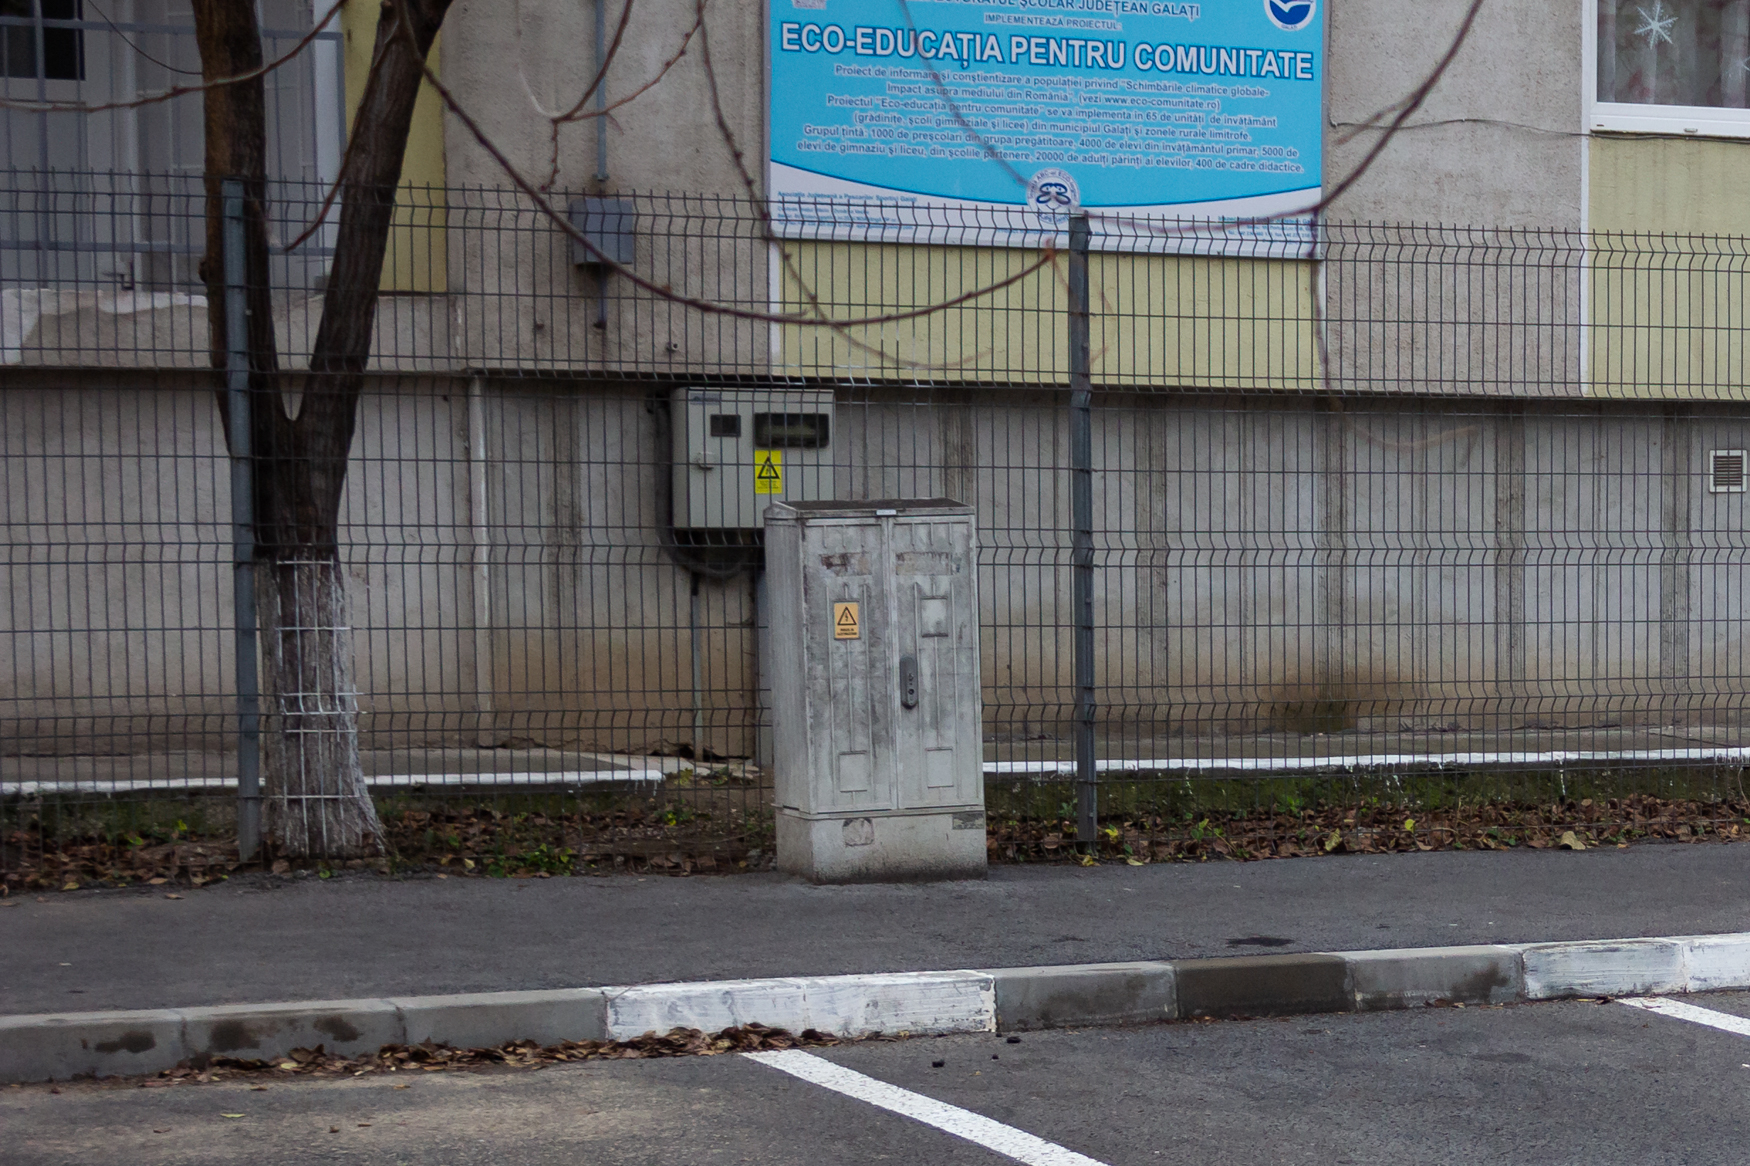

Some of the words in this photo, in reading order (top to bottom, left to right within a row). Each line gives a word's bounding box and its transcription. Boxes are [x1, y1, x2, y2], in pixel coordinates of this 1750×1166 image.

[1010, 36, 1125, 69] PENTRU
[1134, 43, 1313, 80] COMUNITATE
[835, 65, 871, 75] Proiect
[875, 67, 886, 76] de
[1084, 79, 1118, 89] privind
[1186, 84, 1227, 94] climatice
[827, 95, 872, 106] Proiectul
[950, 103, 981, 112] pentru
[1047, 108, 1058, 116] se
[1076, 108, 1131, 119] implementa
[1146, 112, 1157, 120] 65
[1160, 113, 1171, 121] de
[1209, 115, 1221, 124] de
[887, 83, 921, 94] Impact
[925, 86, 958, 96] asupra
[962, 88, 1003, 98] mediului
[1007, 89, 1022, 98] din
[1079, 93, 1101, 104] (vezi
[1104, 96, 1220, 110] www.eco-comunitate.ro)
[804, 125, 838, 137] Grupul
[871, 128, 894, 138] 1000
[897, 129, 909, 139] de
[965, 132, 980, 142] din
[984, 136, 1012, 145] grupa
[1079, 139, 1101, 148] 4000
[1105, 140, 1116, 149] de
[1119, 140, 1141, 150] elevi
[1144, 141, 1159, 150] din
[1226, 146, 1258, 157] primar,
[1262, 147, 1283, 156] 5000
[1287, 148, 1298, 157] de
[1002, 120, 1028, 131] licee)
[1032, 121, 1046, 130] din
[1050, 123, 1100, 133] municipiul
[1145, 127, 1176, 136] zonele
[1179, 129, 1206, 138] rurale
[1210, 130, 1250, 140] limitrofe.
[797, 141, 821, 150] elevi
[824, 142, 836, 151] de
[840, 143, 885, 154] gimnaziu
[900, 145, 926, 156] liceu,
[930, 146, 945, 156] din
[1036, 151, 1064, 161] 20000
[1067, 153, 1078, 162] de
[1145, 156, 1153, 165] ai
[1196, 159, 1212, 168] 400
[1215, 160, 1226, 169] de
[1229, 161, 1255, 170] cadre
[1259, 162, 1303, 172] didactice.
